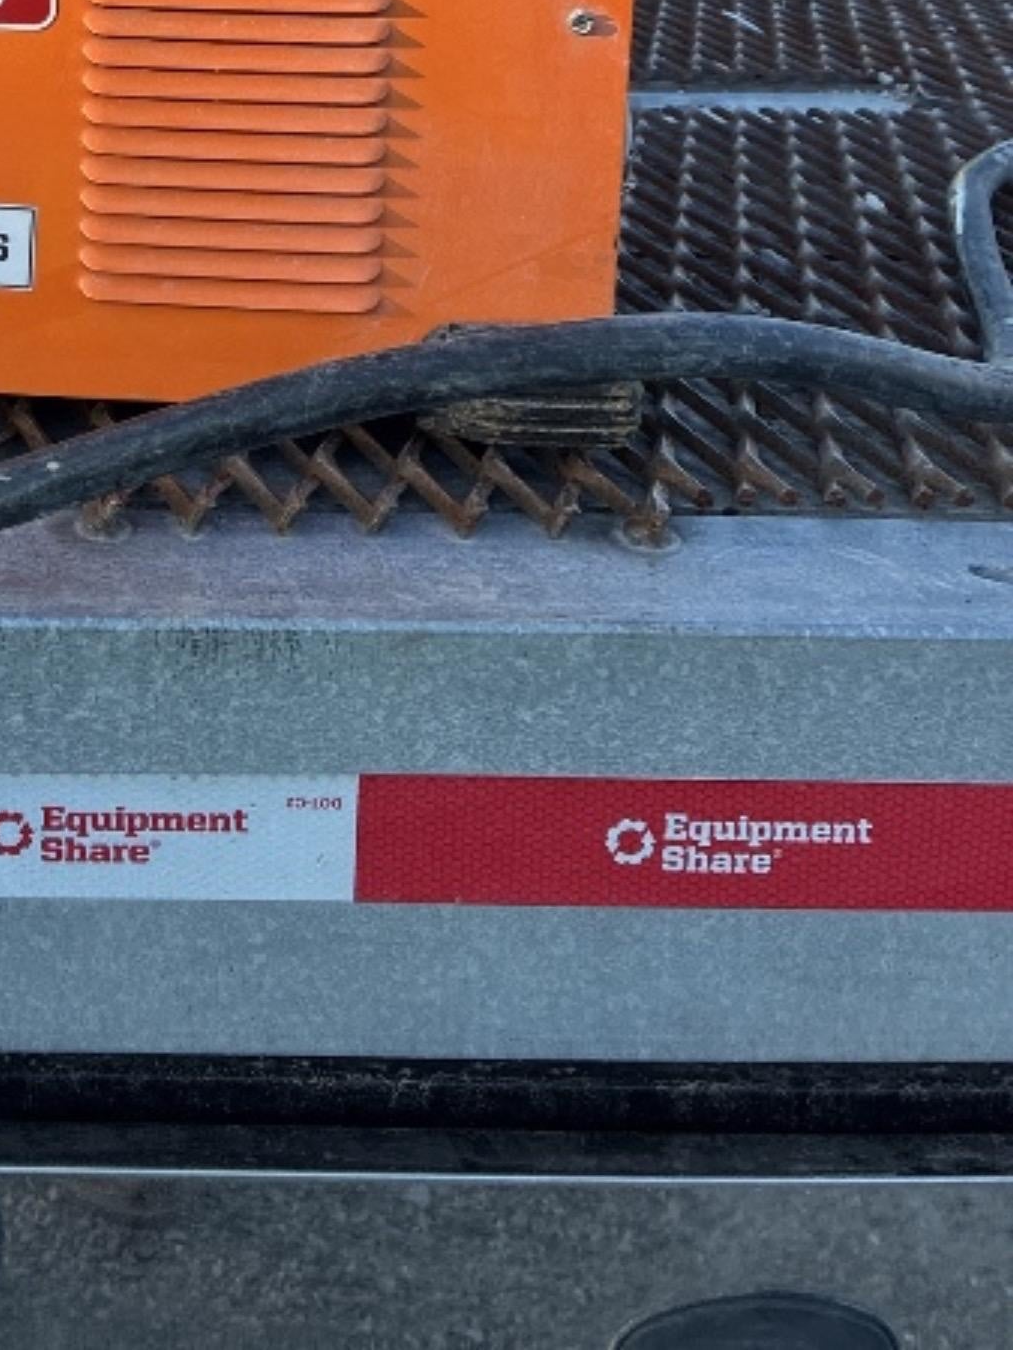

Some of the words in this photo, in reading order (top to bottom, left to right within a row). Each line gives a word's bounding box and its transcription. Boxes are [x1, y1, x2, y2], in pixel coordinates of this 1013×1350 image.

[40, 805, 249, 835] Equipment
[662, 811, 873, 847] Equipment
[40, 836, 151, 864] Share
[661, 845, 772, 874] Share
